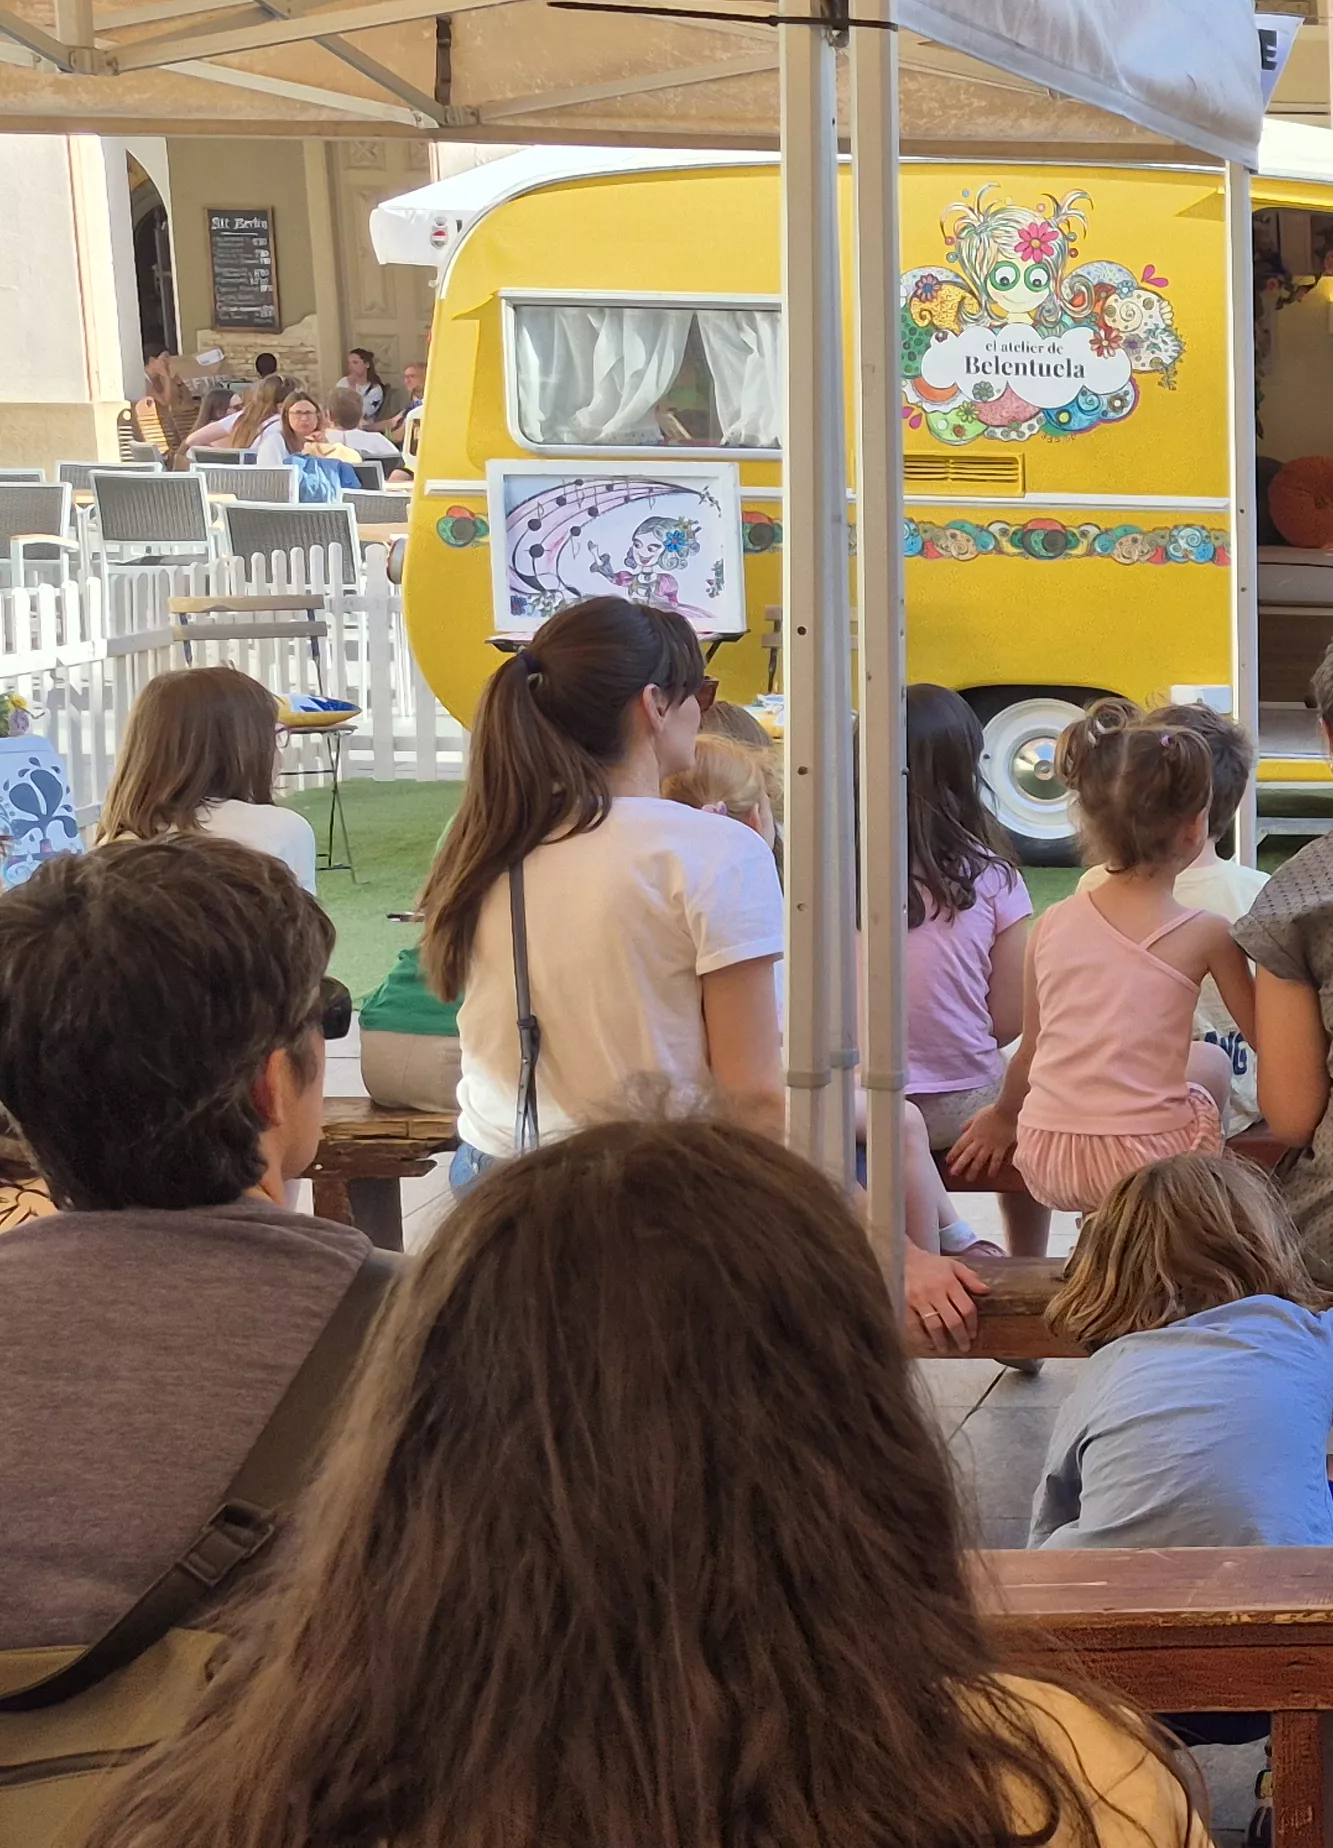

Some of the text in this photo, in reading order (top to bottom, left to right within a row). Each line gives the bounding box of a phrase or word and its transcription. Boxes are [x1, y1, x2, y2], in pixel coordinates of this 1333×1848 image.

[1258, 28, 1277, 71] E
[985, 340, 1063, 354] el atelier de
[965, 355, 1085, 378] Belentuela
